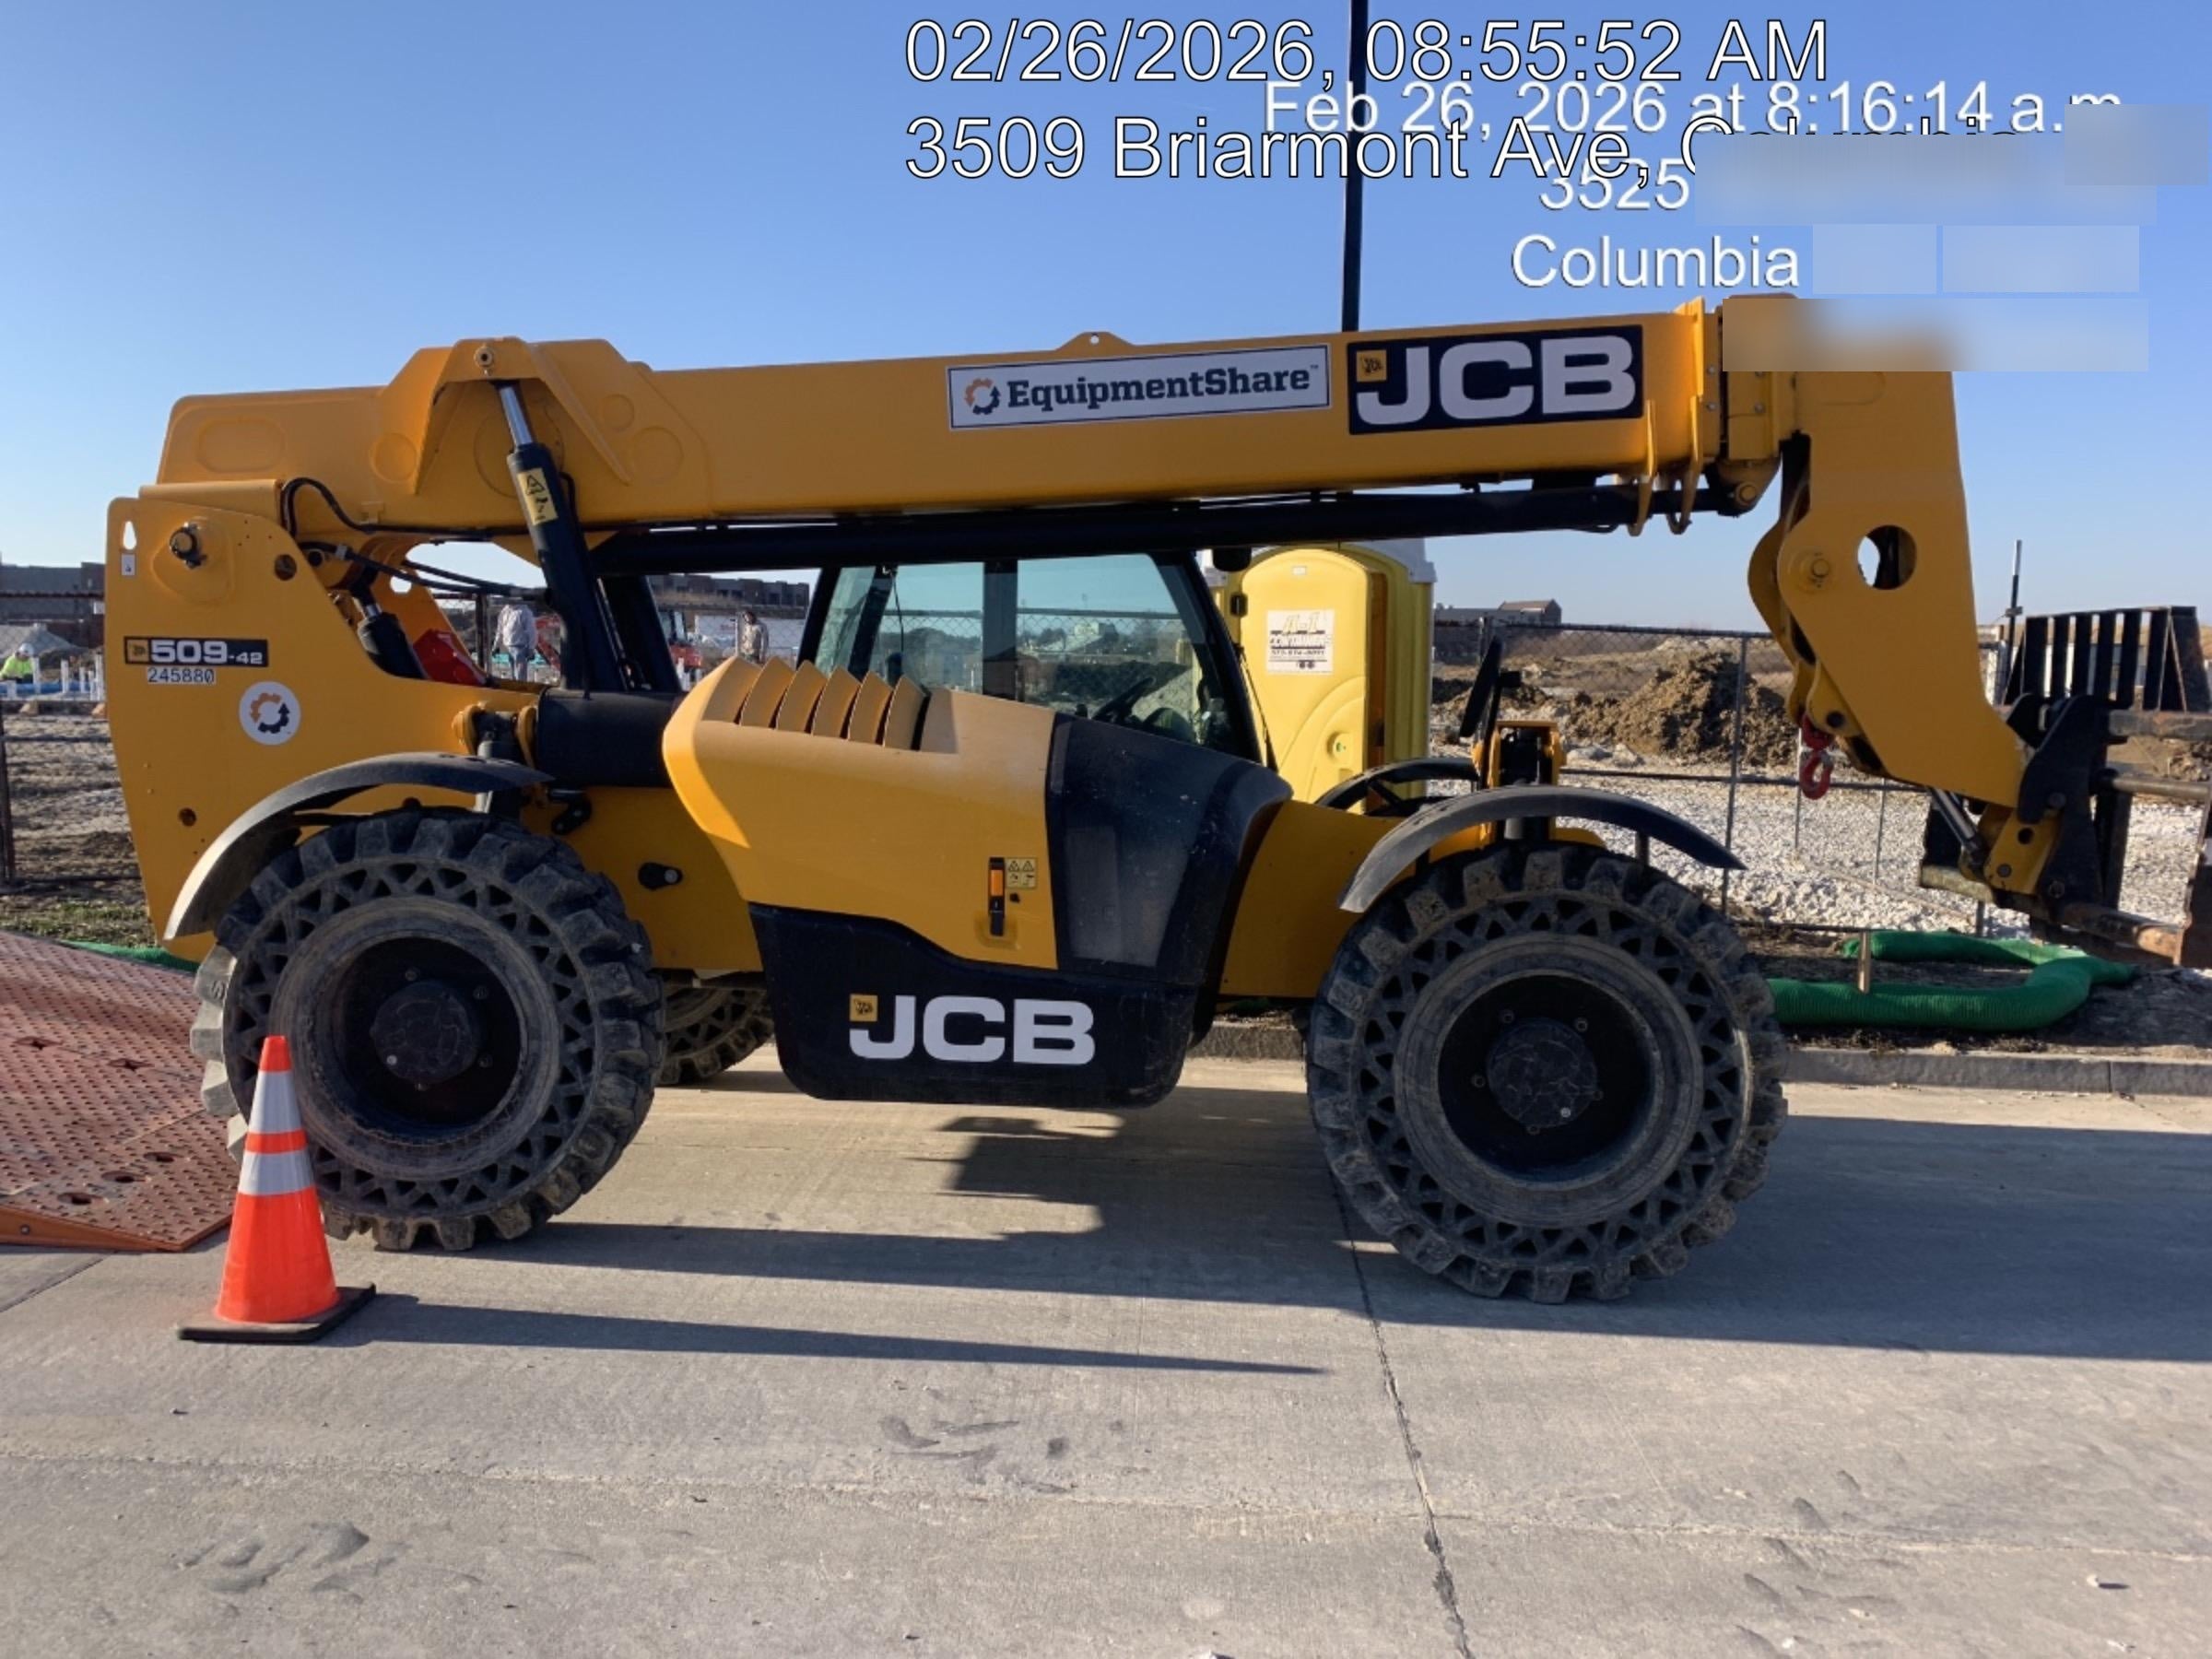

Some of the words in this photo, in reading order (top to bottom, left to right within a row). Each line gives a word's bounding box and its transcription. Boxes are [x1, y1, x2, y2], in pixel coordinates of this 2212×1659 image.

[1006, 367, 1311, 411] EquipmentShare
[1356, 335, 1637, 425] JCB
[147, 667, 215, 684] 245880
[849, 994, 1096, 1065] JCB
